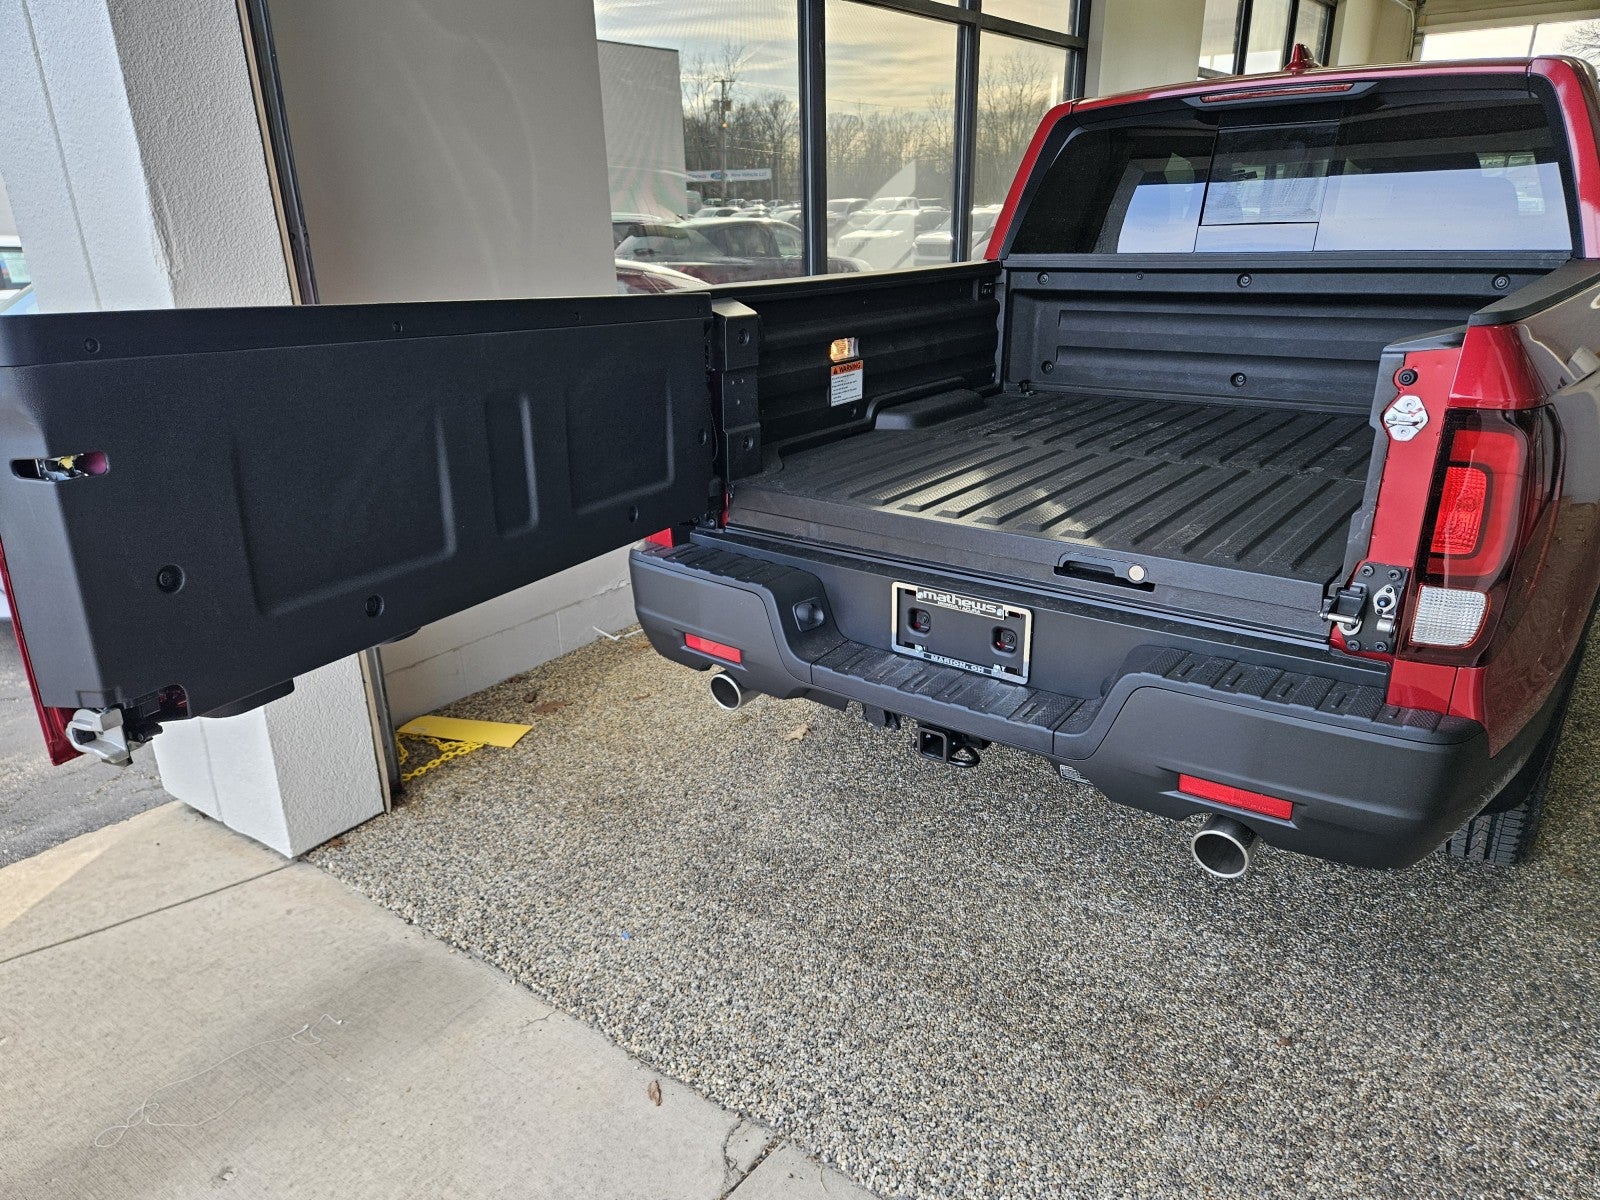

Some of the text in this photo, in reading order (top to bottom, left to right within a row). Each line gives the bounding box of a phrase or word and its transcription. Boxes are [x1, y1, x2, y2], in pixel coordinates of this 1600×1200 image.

[840, 362, 861, 373] WARNING
[923, 591, 996, 613] mathews
[931, 655, 984, 673] MARION, OH
